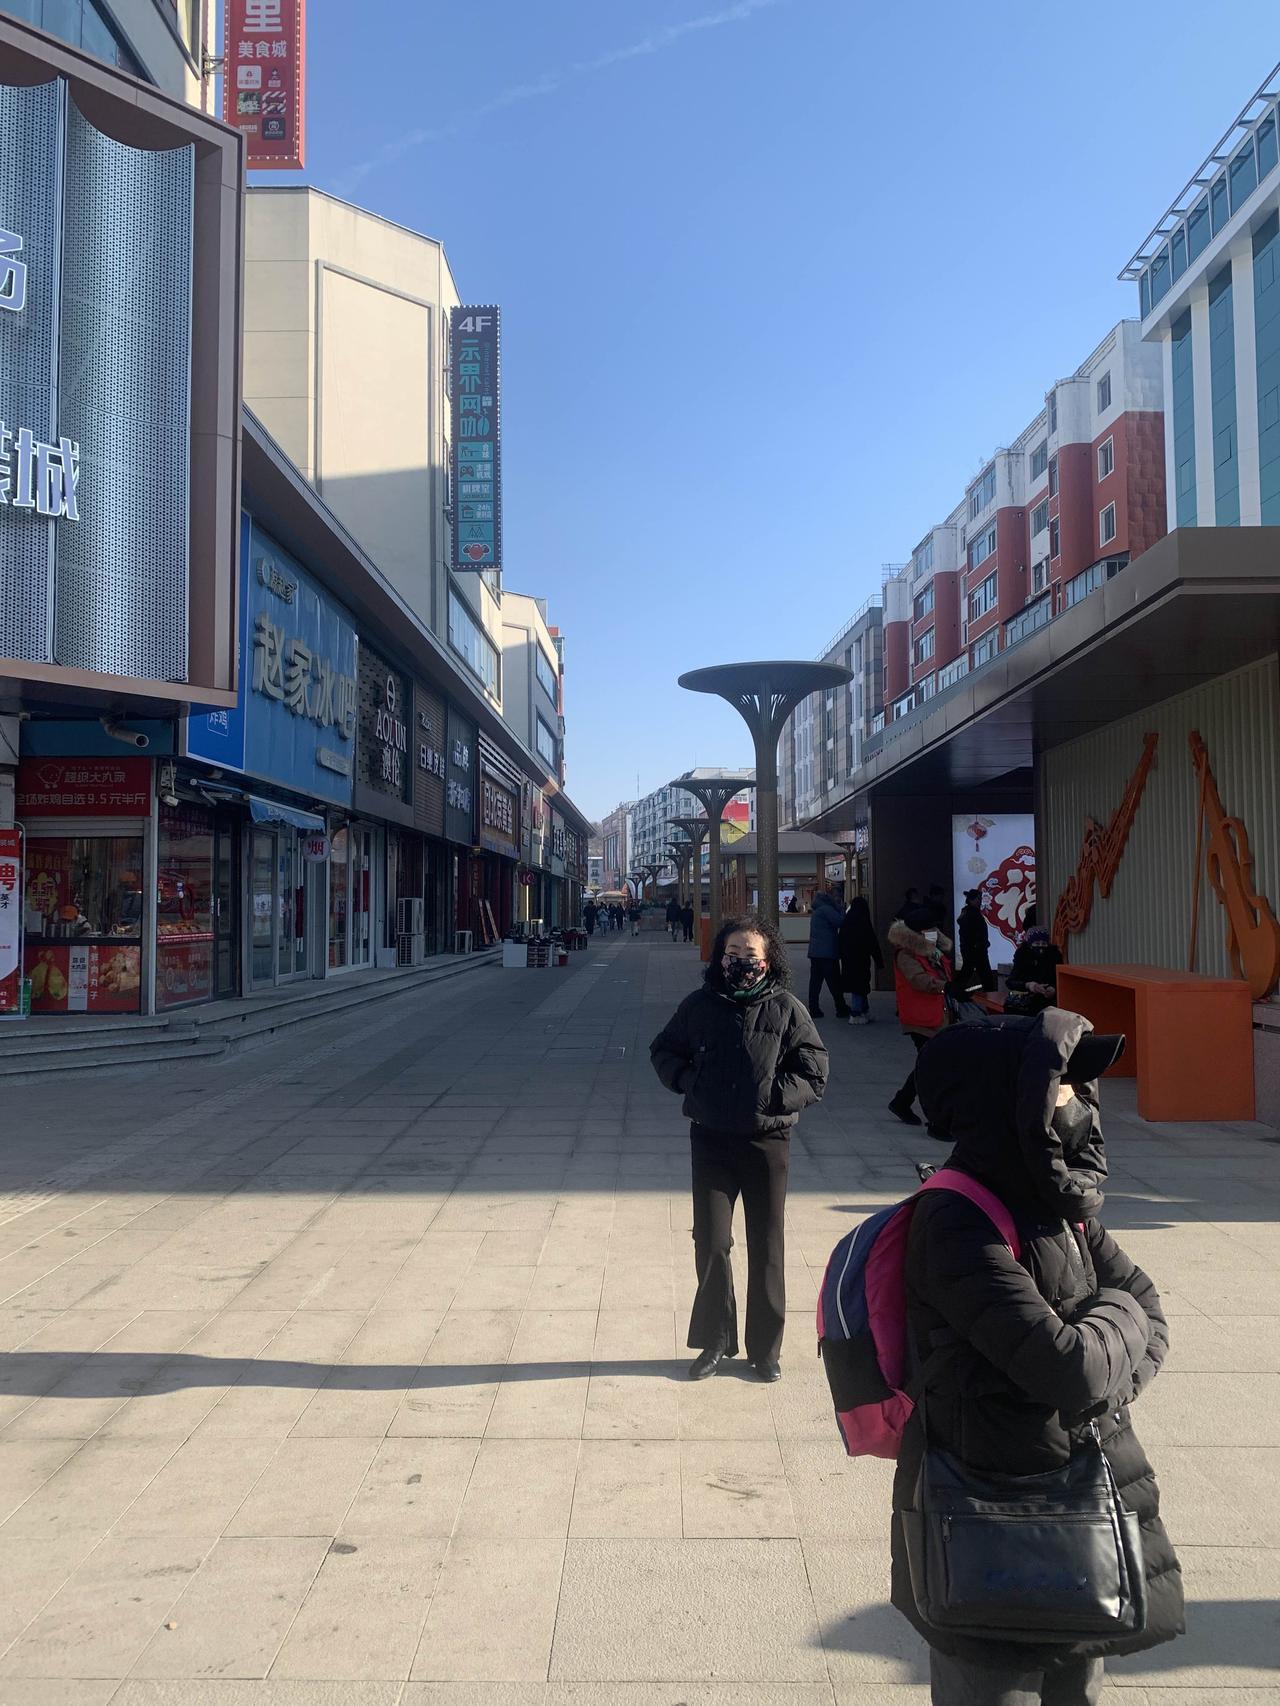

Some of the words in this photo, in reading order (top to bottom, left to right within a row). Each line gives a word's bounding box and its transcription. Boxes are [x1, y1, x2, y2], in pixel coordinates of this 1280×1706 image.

[238, 40, 287, 58] 美食城
[459, 316, 492, 332] 4F
[253, 611, 356, 741] 赵家冰吧
[308, 840, 325, 856] 烟
